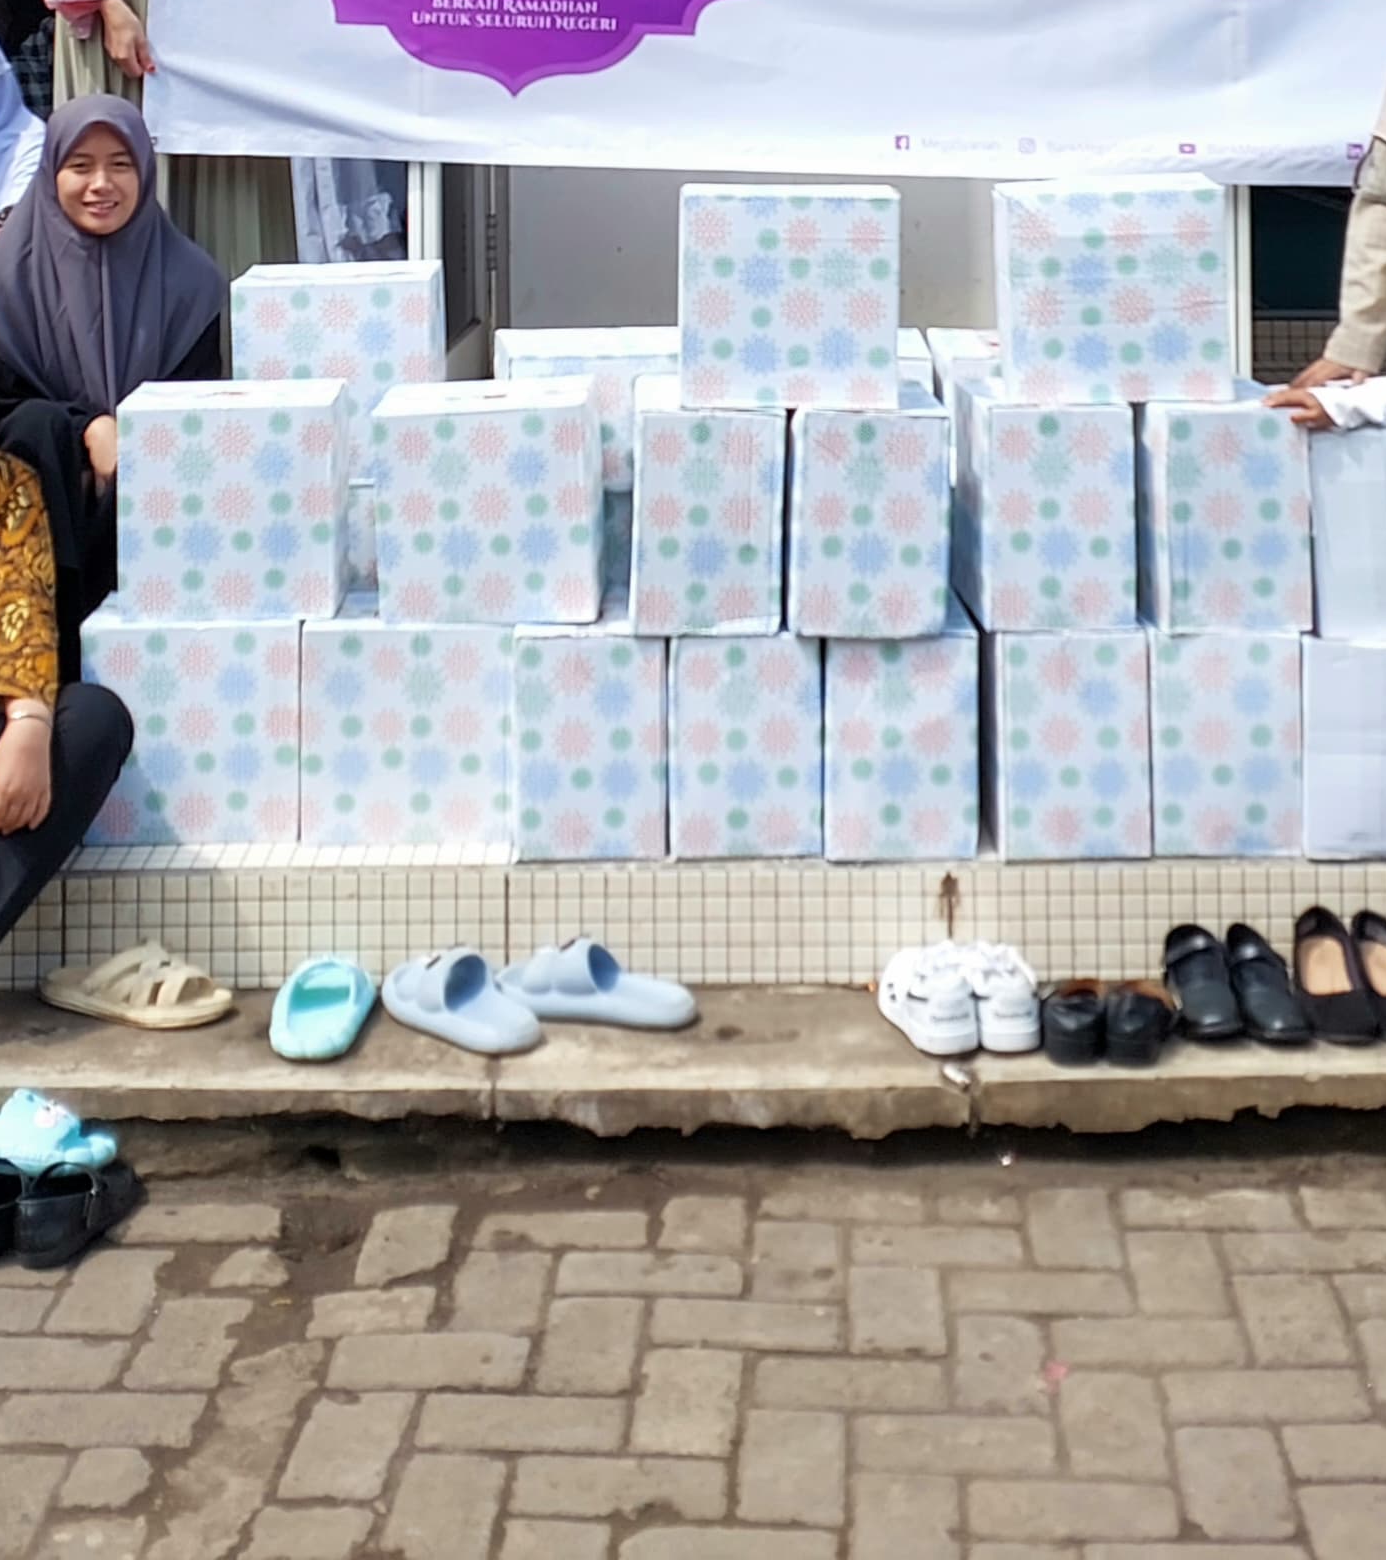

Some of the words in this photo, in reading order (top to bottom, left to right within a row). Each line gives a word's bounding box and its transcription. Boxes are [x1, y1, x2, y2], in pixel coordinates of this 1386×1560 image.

[412, 11, 471, 26] UNTUK
[475, 13, 551, 29] SELURUH
[553, 14, 617, 32] NEGERI
